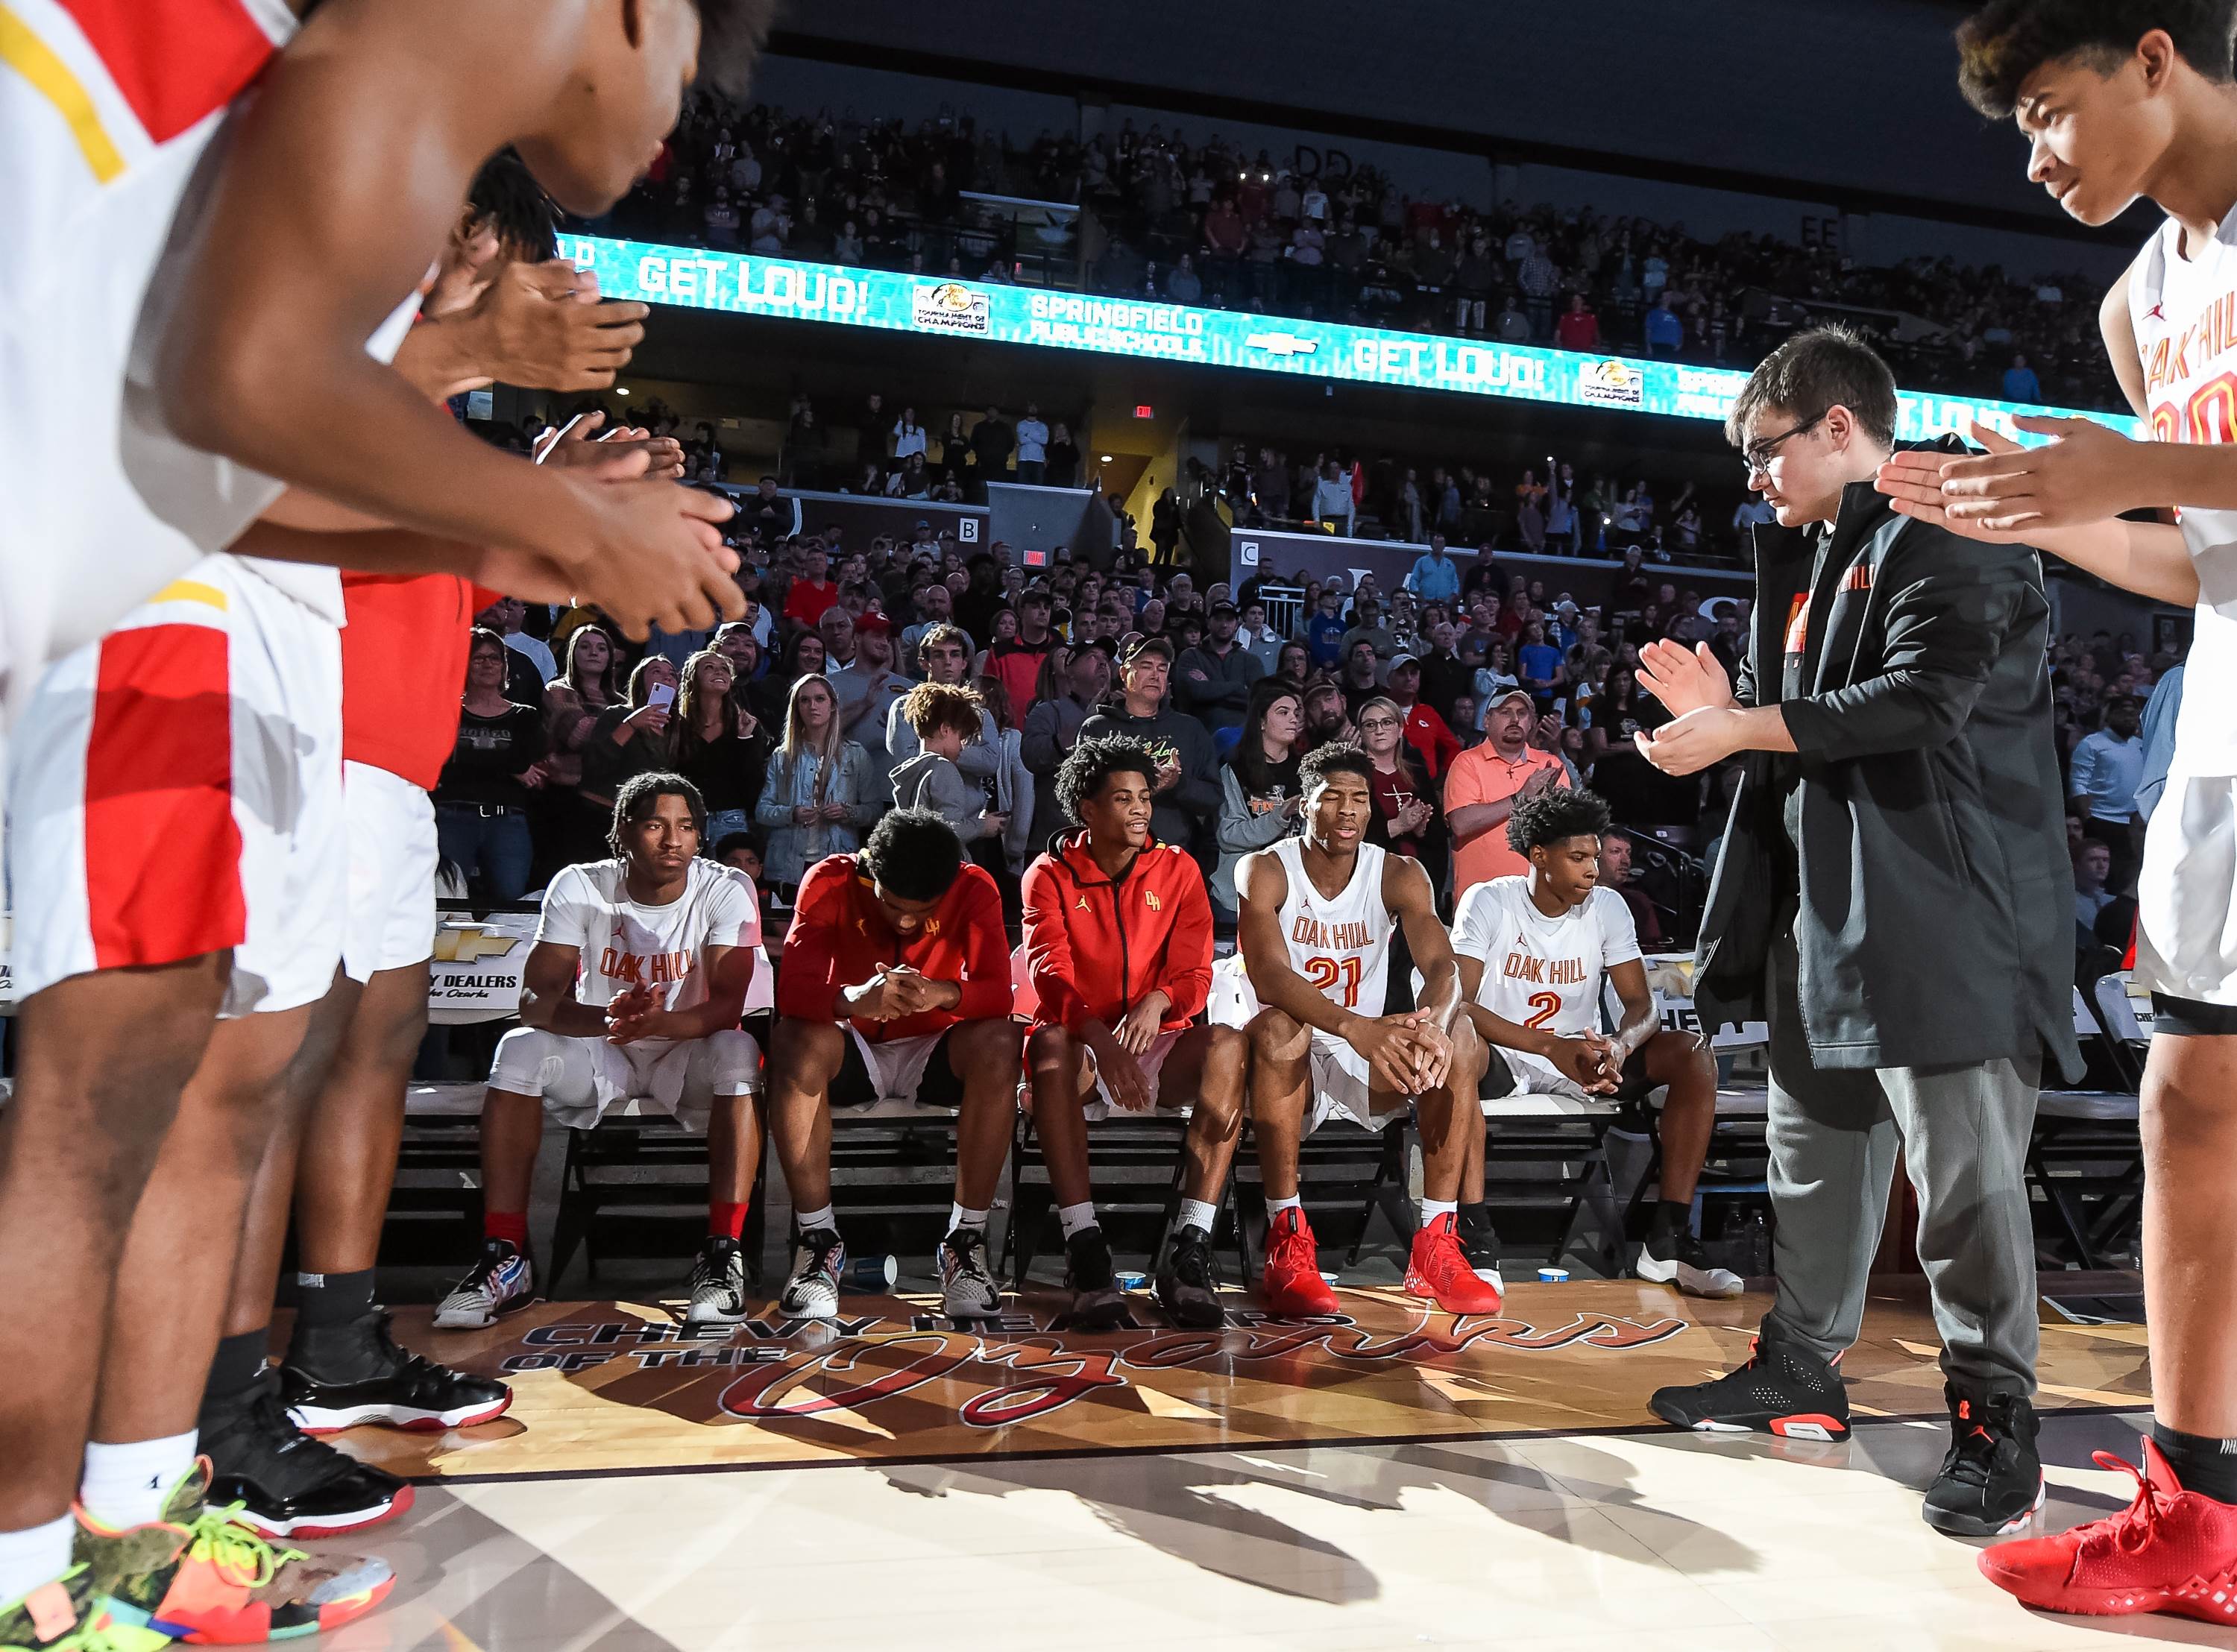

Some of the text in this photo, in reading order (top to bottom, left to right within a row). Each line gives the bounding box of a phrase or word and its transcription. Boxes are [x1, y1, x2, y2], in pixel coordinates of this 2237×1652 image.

[638, 256, 869, 316] GET LOUD!
[1031, 294, 1203, 335] SPRINGFIELD
[1030, 319, 1204, 358] PUBLIC SCHOOLS
[1353, 338, 1428, 376] GET
[1436, 342, 1544, 390] LOUD!
[963, 522, 974, 538] B
[1244, 546, 1256, 562] C
[1292, 915, 1374, 950] OAK HILL
[443, 974, 517, 989] DEALERS
[600, 947, 695, 983] OAK HILL
[1304, 956, 1362, 1008] 21
[1504, 952, 1588, 984] OAK HILL
[446, 989, 490, 998] Ozarks
[1523, 991, 1562, 1035] 2
[523, 1310, 1357, 1346] CHEVY DELRS
[500, 1347, 796, 1372] OF THE
[717, 1297, 1690, 1428] Ozarks
